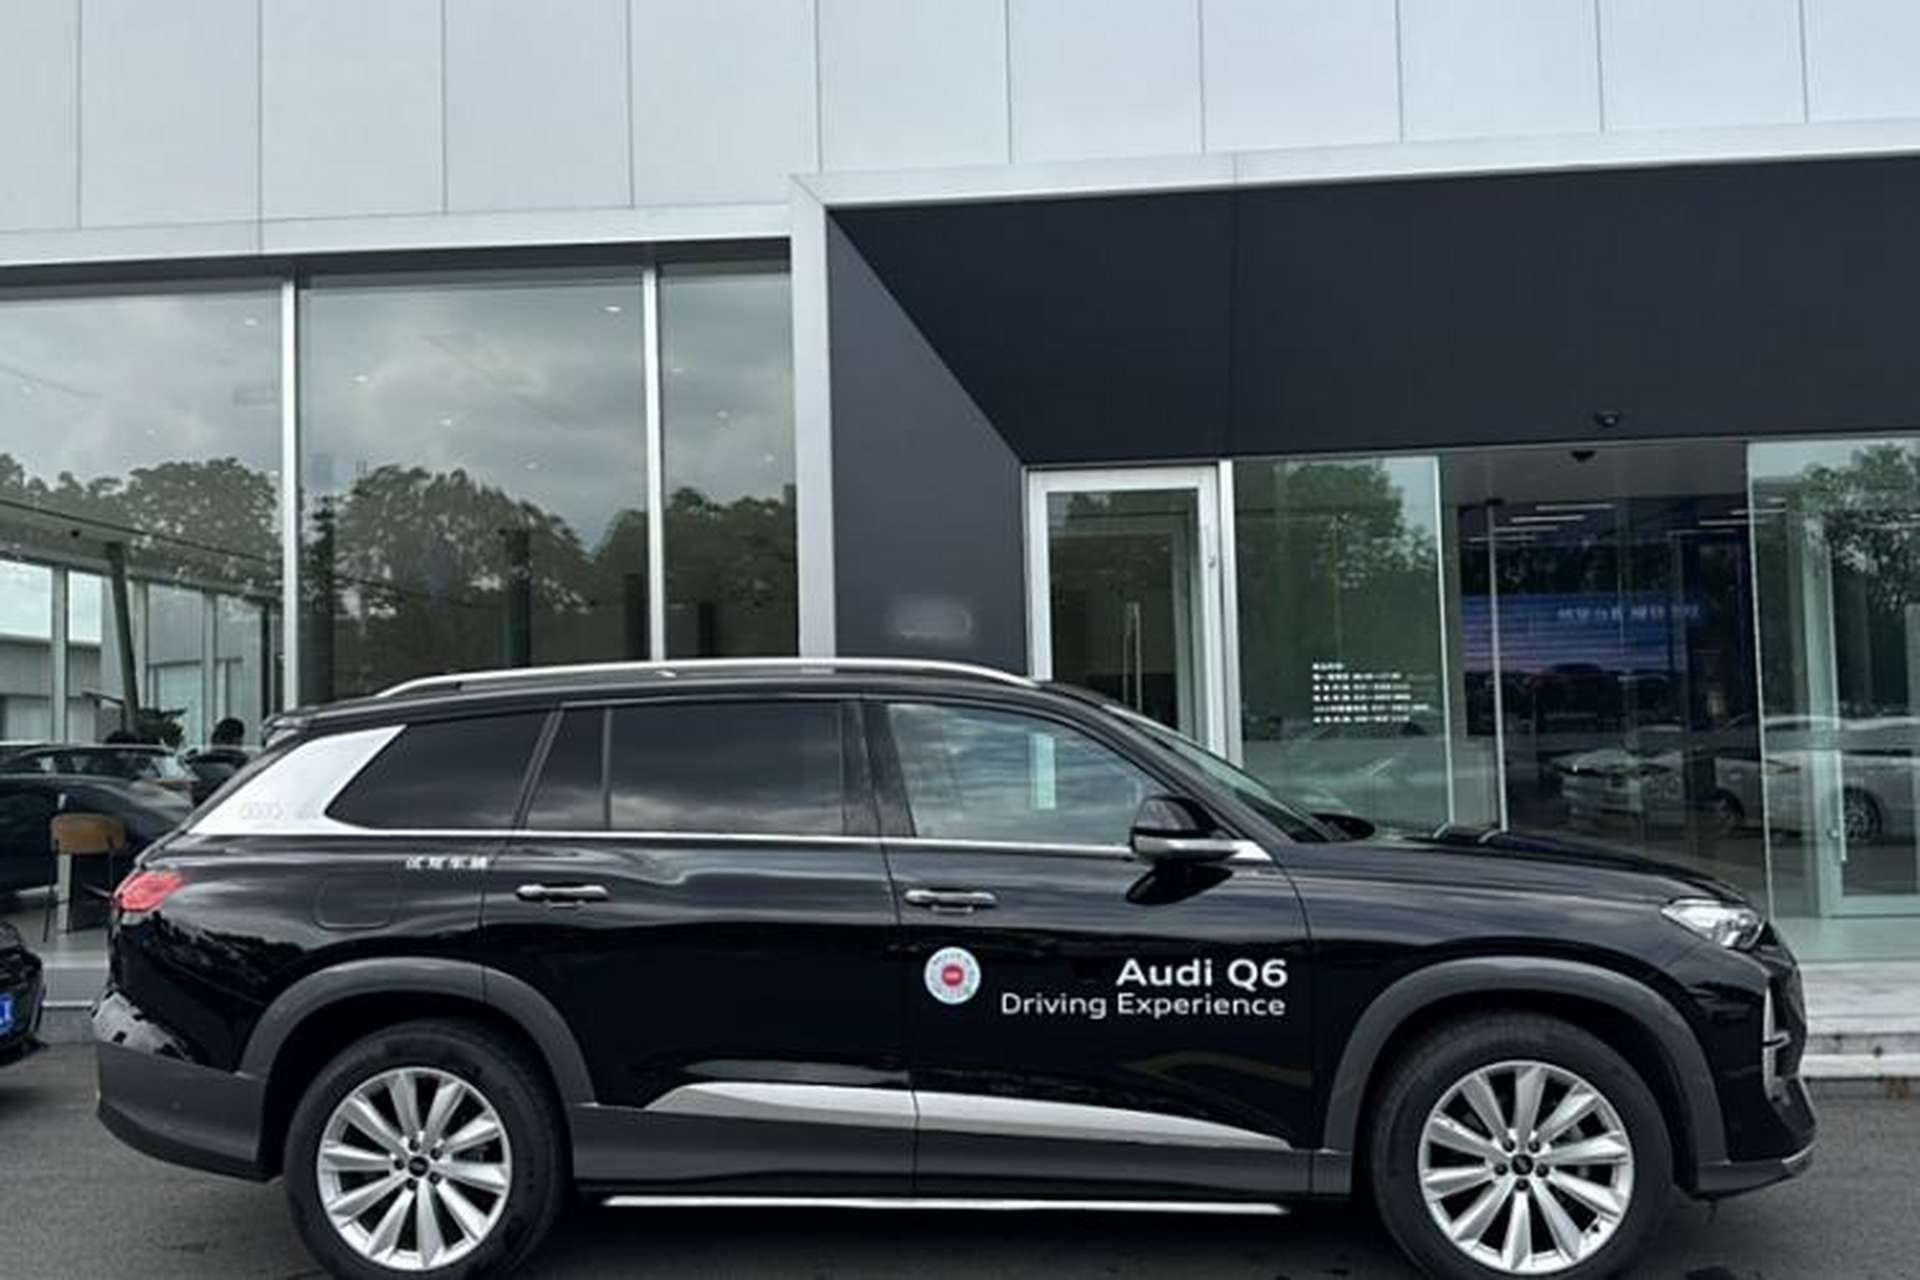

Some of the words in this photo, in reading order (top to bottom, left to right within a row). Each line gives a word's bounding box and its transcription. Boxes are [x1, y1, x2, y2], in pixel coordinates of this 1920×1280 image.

[1115, 958, 1213, 987] Audi
[1227, 958, 1288, 992] Q6
[1001, 993, 1107, 1020] Driving
[1117, 993, 1286, 1020] Experience
